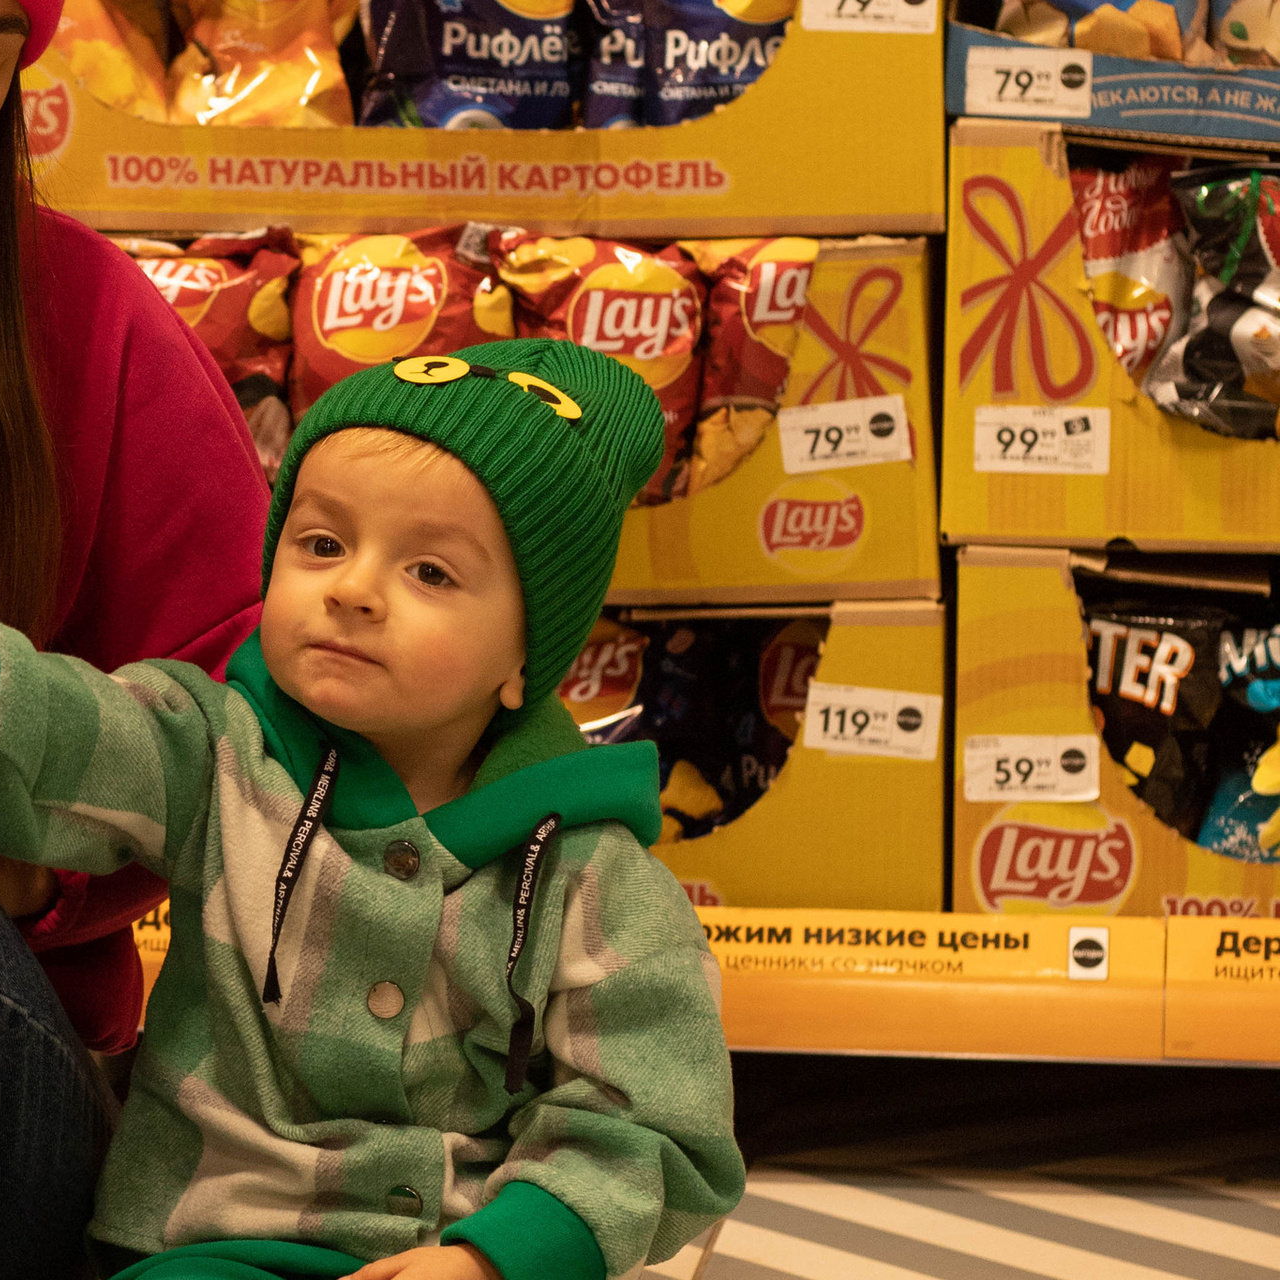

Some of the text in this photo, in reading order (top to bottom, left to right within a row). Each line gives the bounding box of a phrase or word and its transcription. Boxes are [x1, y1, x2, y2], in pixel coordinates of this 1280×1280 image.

[995, 68, 1033, 97] 79
[108, 155, 725, 192] 100% НАТУРАЛЬНЫЙ КАРТОФЕЛЬ
[323, 263, 437, 332] Lay's
[581, 288, 694, 359] Lay's
[804, 426, 844, 455] 79
[996, 426, 1039, 455] 99
[819, 706, 871, 735] 119
[994, 757, 1033, 786] 59
[282, 775, 331, 878] MERLIN& PERCIVAL&
[518, 843, 541, 905] PERCIVAL&
[989, 820, 1123, 908] Lay's
[804, 926, 927, 949] низкие
[938, 928, 1030, 956] цены
[725, 953, 823, 975] ценники
